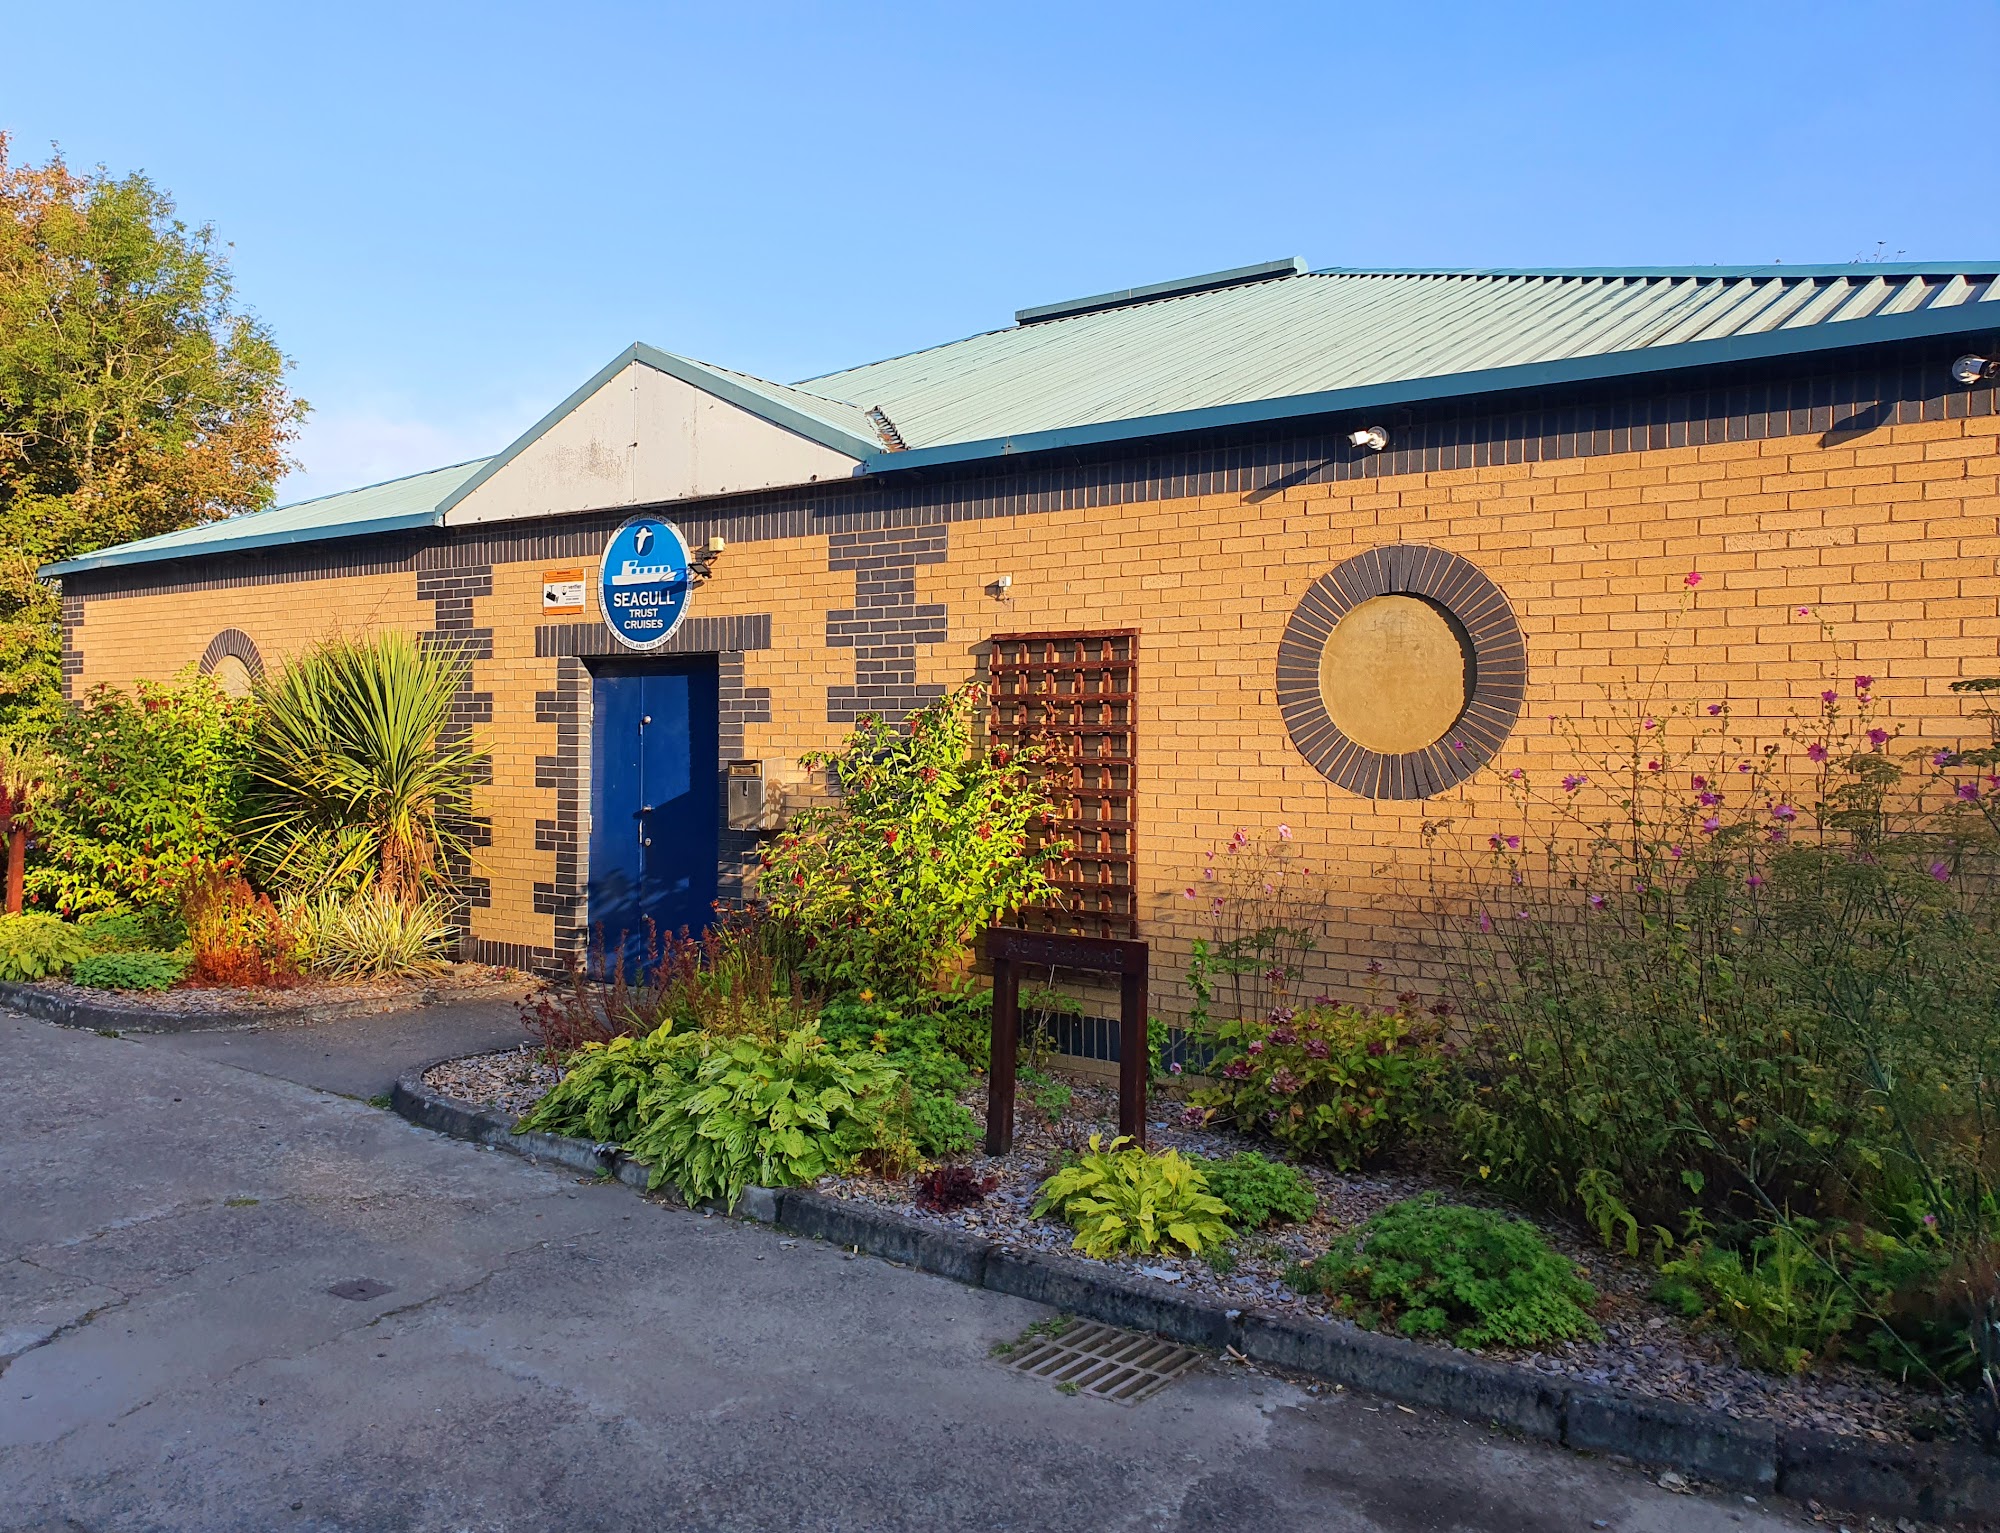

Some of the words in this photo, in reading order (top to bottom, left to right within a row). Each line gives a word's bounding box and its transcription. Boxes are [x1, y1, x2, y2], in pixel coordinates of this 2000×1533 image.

[613, 591, 675, 607] SEAGULL
[602, 608, 618, 635] CRUISING
[621, 636, 646, 649] SCOTLAND
[646, 641, 656, 650] FOR
[656, 628, 673, 645] PEOPLE
[673, 615, 684, 630] WITH
[682, 588, 693, 614] SPECIAL
[629, 608, 659, 618] TRUST
[624, 619, 664, 630] CRUISES
[1005, 936, 1030, 956] NO
[1045, 939, 1123, 964] PARNG
